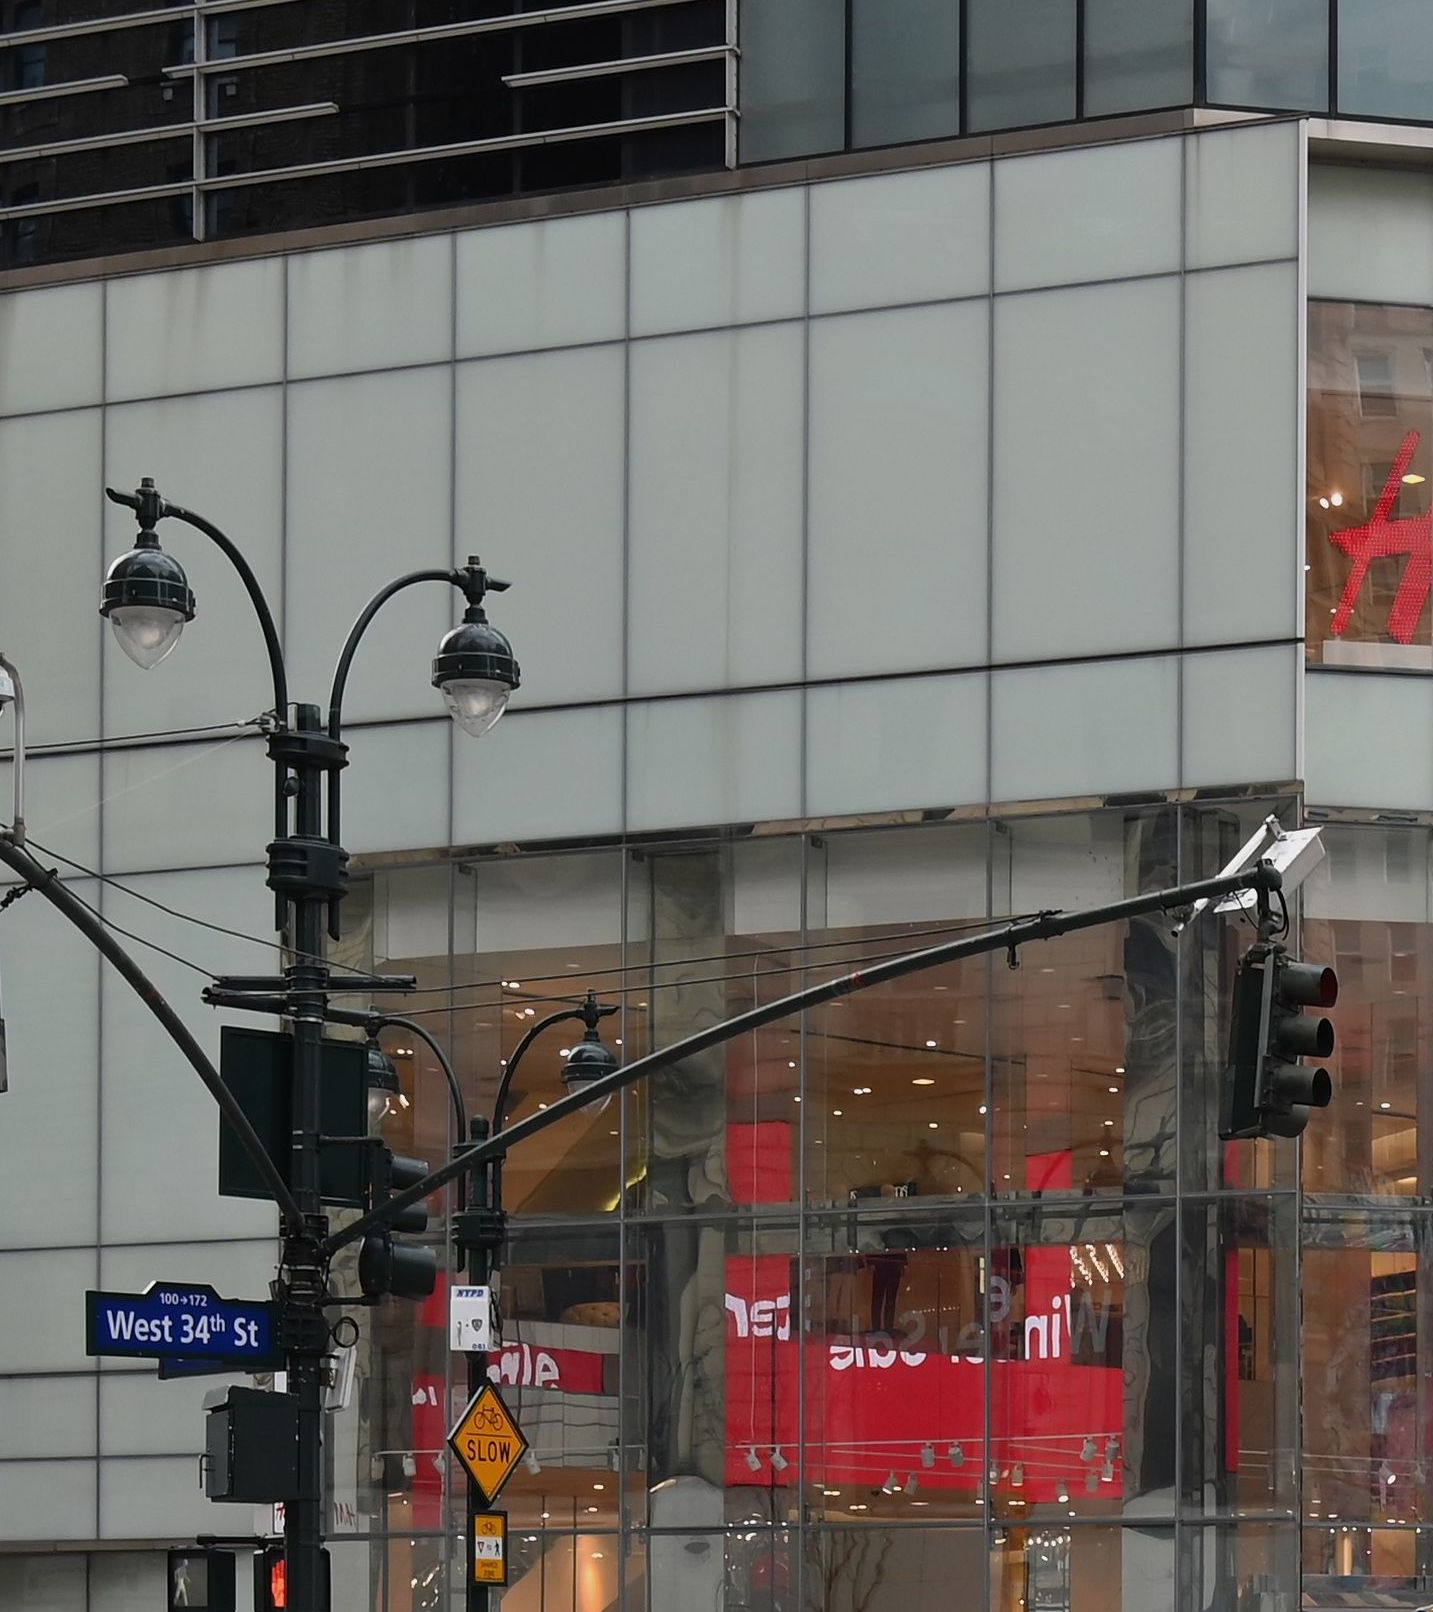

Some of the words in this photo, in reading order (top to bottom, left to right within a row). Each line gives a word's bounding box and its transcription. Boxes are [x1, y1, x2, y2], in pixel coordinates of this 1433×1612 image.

[160, 1292, 179, 1306] 100
[189, 1295, 208, 1308] 172
[456, 1289, 484, 1298] NYPD
[106, 1309, 173, 1343] West
[180, 1313, 225, 1345] 34th
[233, 1316, 259, 1348] St
[467, 1439, 511, 1464] SLOW
